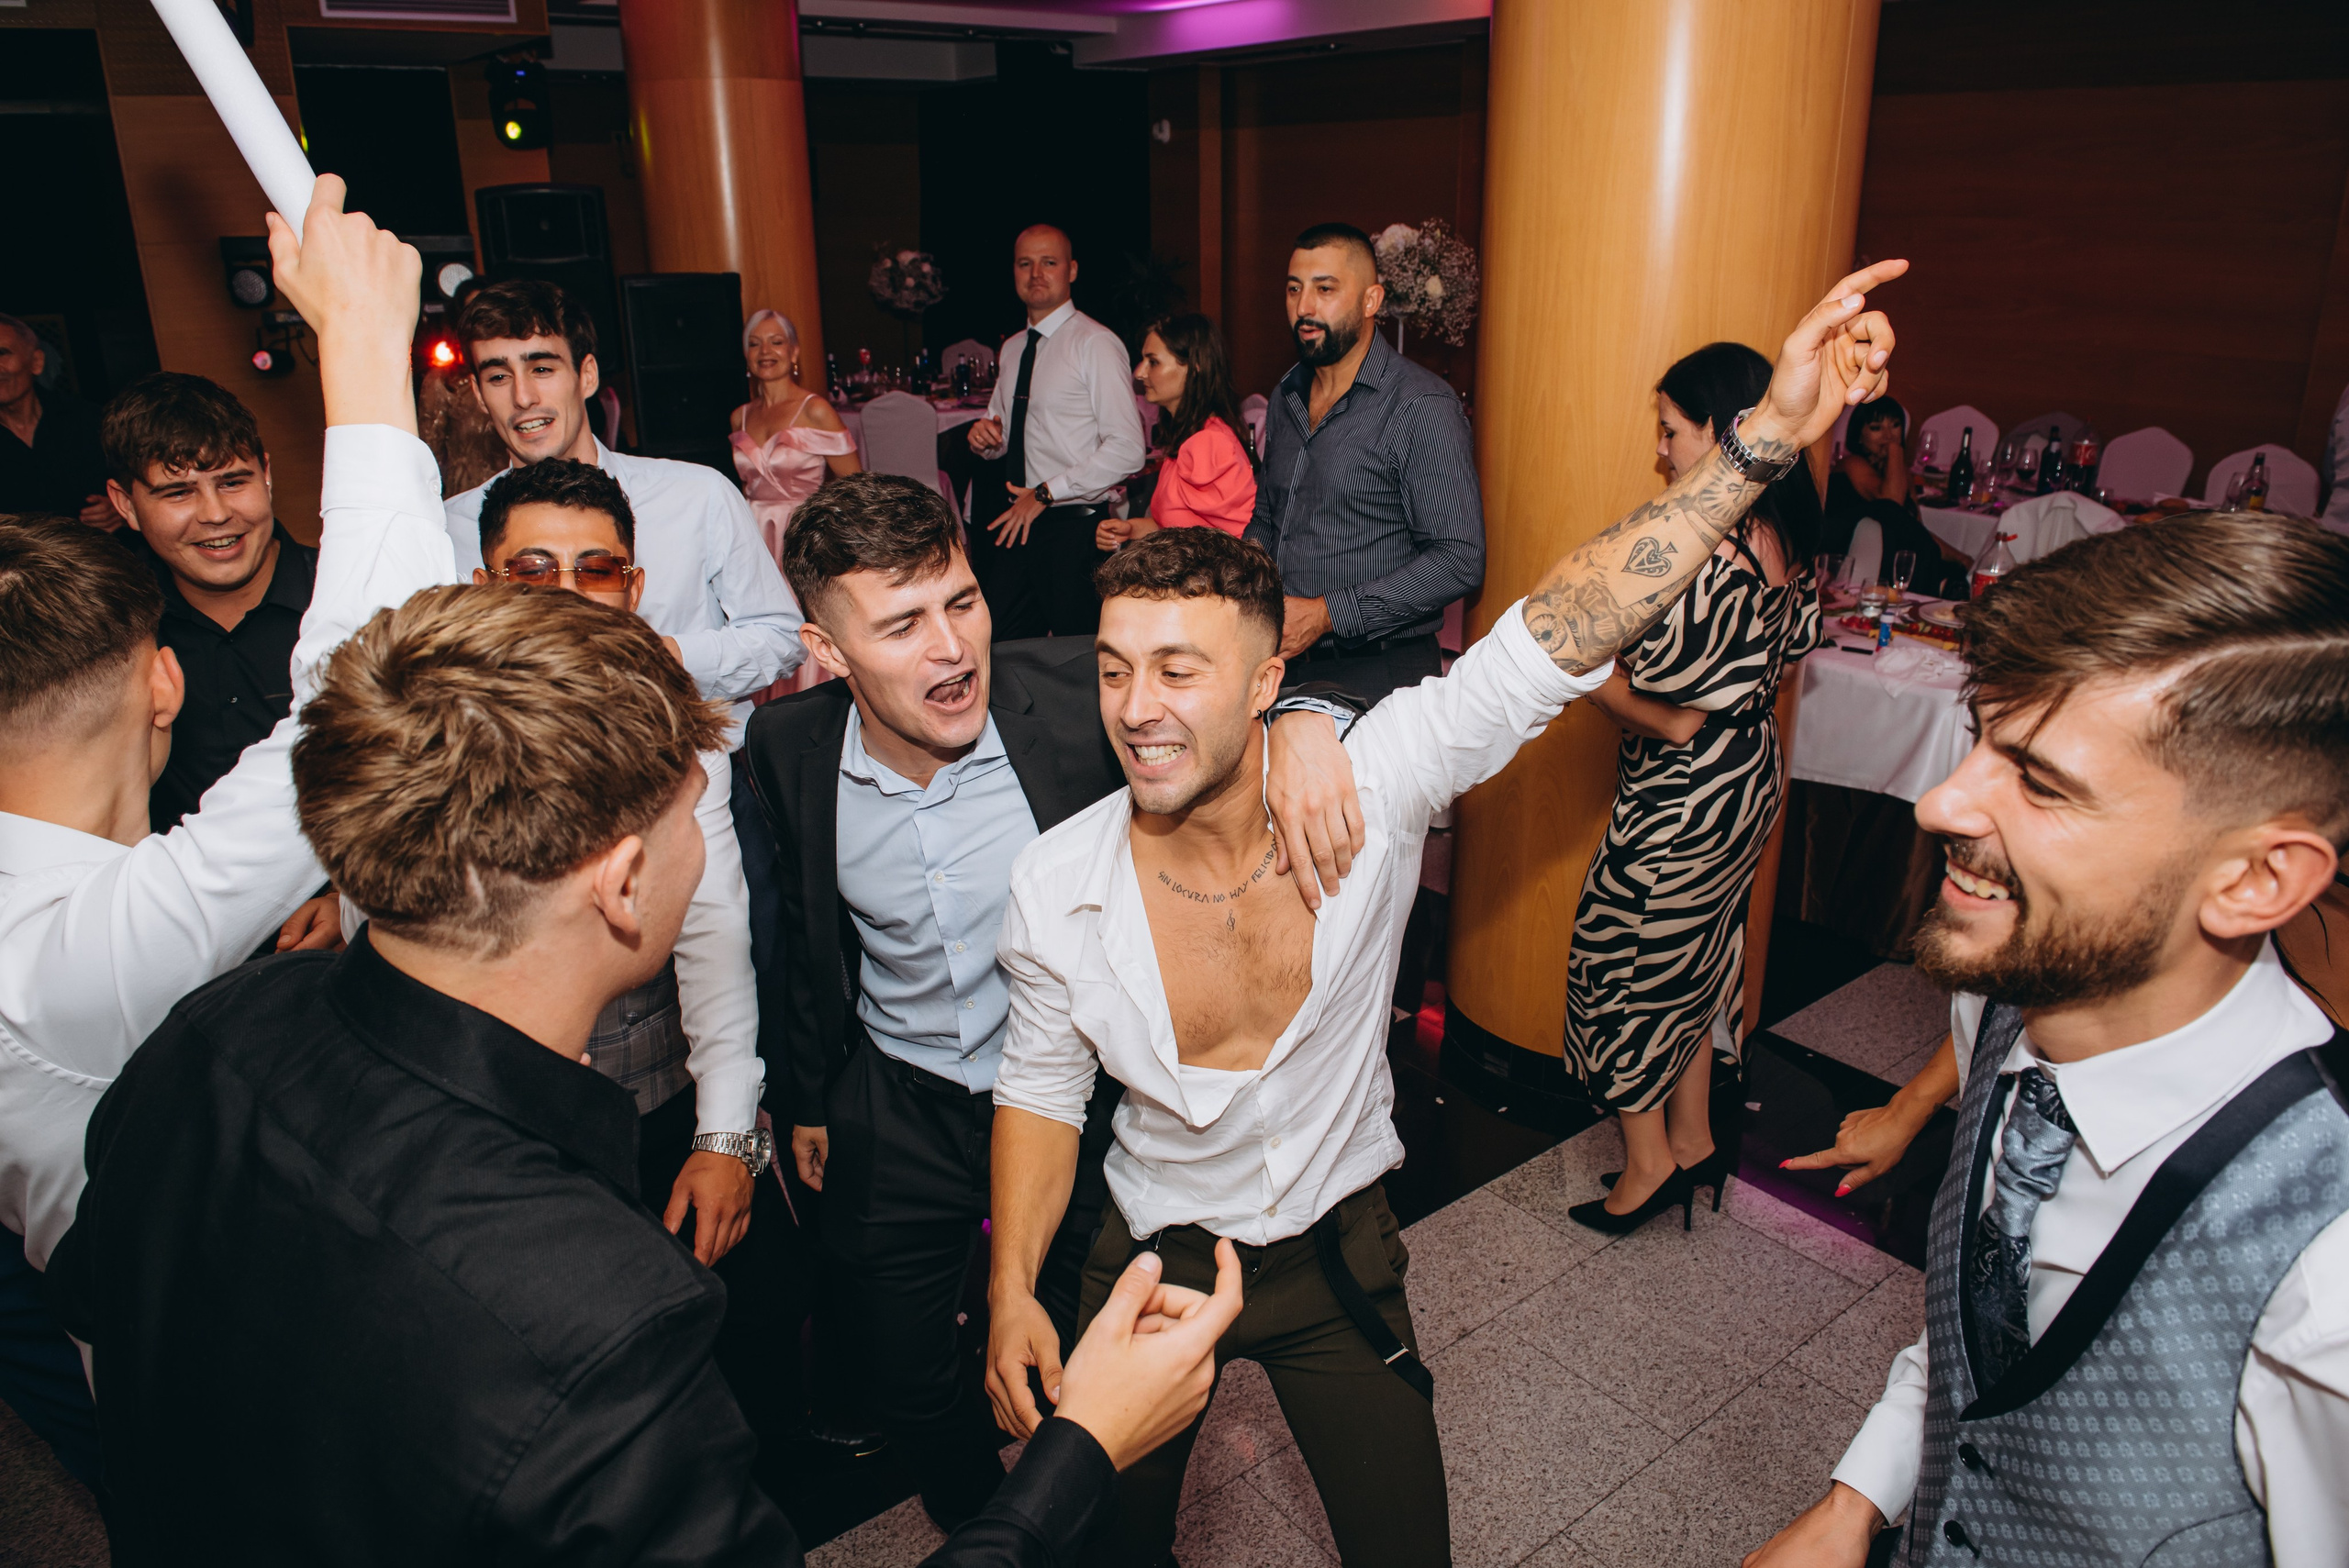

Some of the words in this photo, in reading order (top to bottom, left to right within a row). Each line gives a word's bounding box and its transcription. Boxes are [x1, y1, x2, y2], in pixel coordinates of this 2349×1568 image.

[1158, 871, 1172, 885] SIN
[1171, 882, 1209, 904] LOCURA
[1212, 893, 1226, 904] NO
[1229, 880, 1249, 899] HAY
[1251, 836, 1276, 884] FELICIDA
